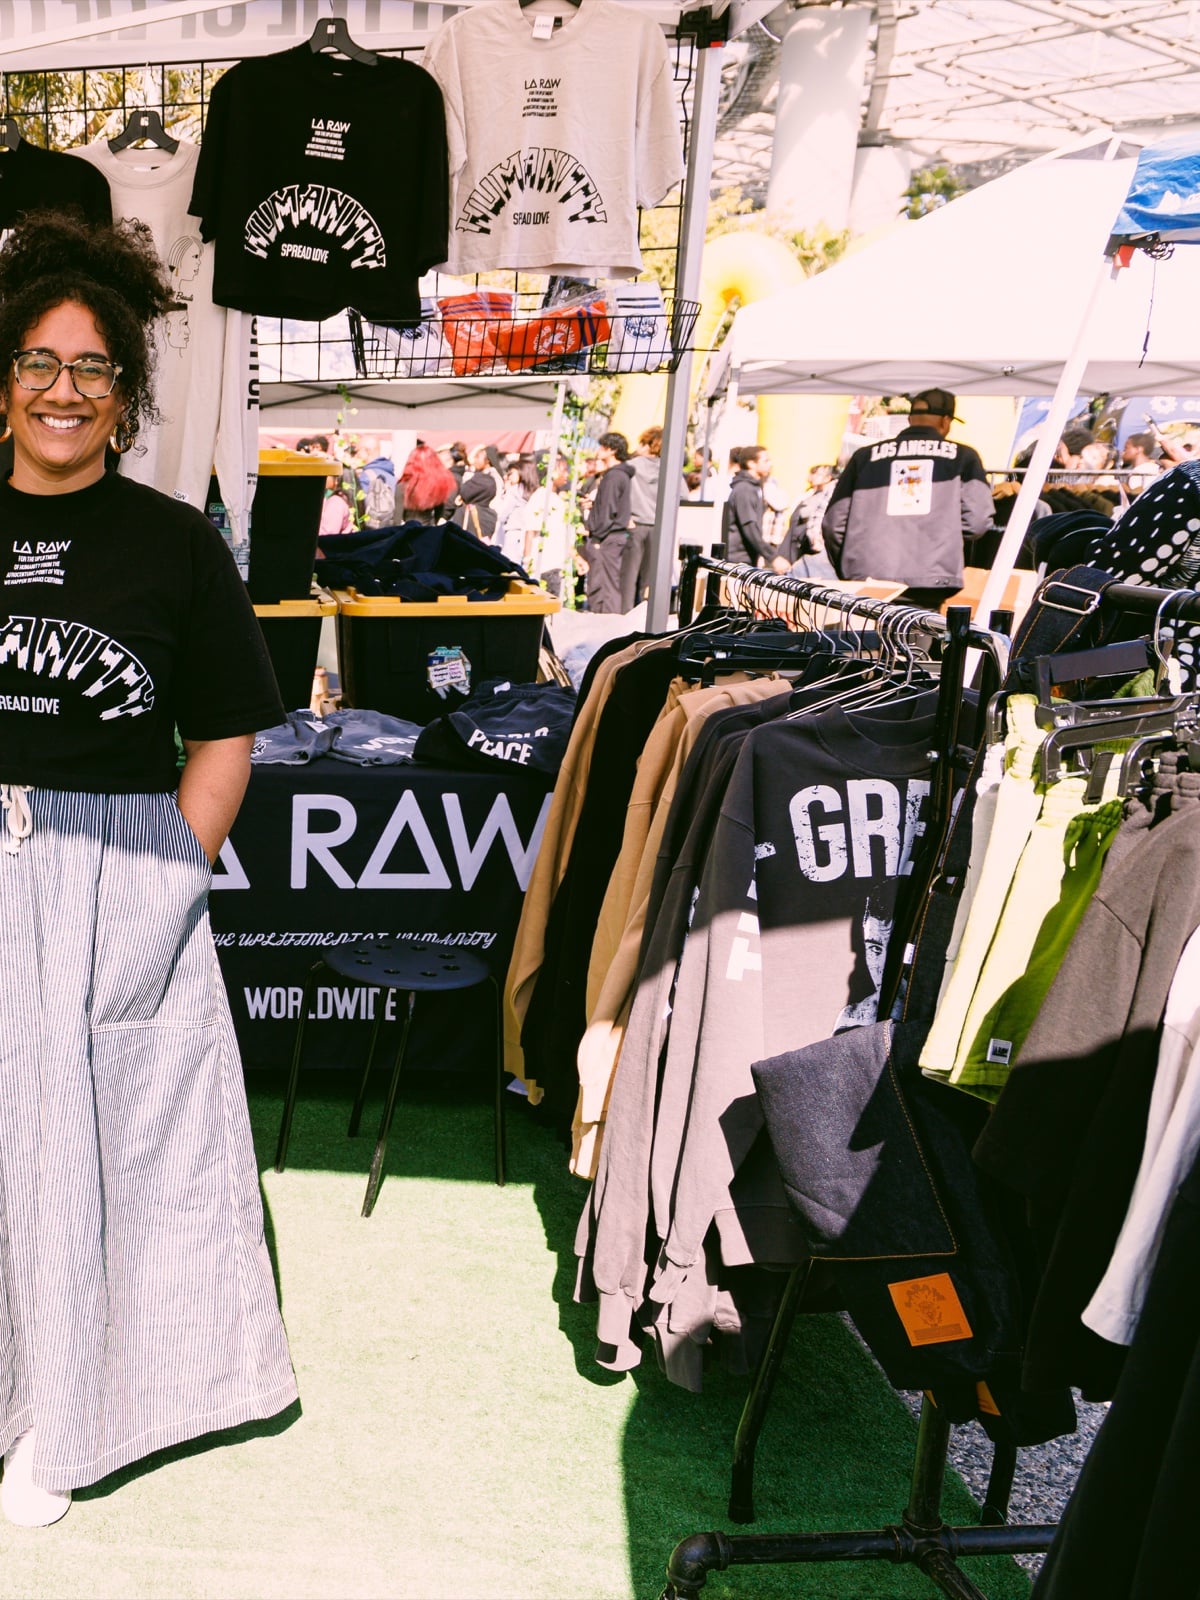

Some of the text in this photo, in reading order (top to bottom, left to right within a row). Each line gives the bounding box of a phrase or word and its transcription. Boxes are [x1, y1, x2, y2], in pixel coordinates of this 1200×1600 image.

[525, 78, 561, 90] LA RAW
[311, 118, 351, 133] LA RAW
[454, 147, 608, 235] HUMANITY
[244, 184, 387, 270] HUMANITY
[532, 210, 550, 225] LOVE
[280, 243, 329, 265] SPREAD LOVE
[870, 440, 958, 462] LOS ANGELES
[12, 539, 72, 554] LA RAW
[32, 697, 60, 715] LOVE
[467, 728, 534, 766] PEACE
[290, 789, 557, 892] RAW
[788, 778, 932, 883] GRE
